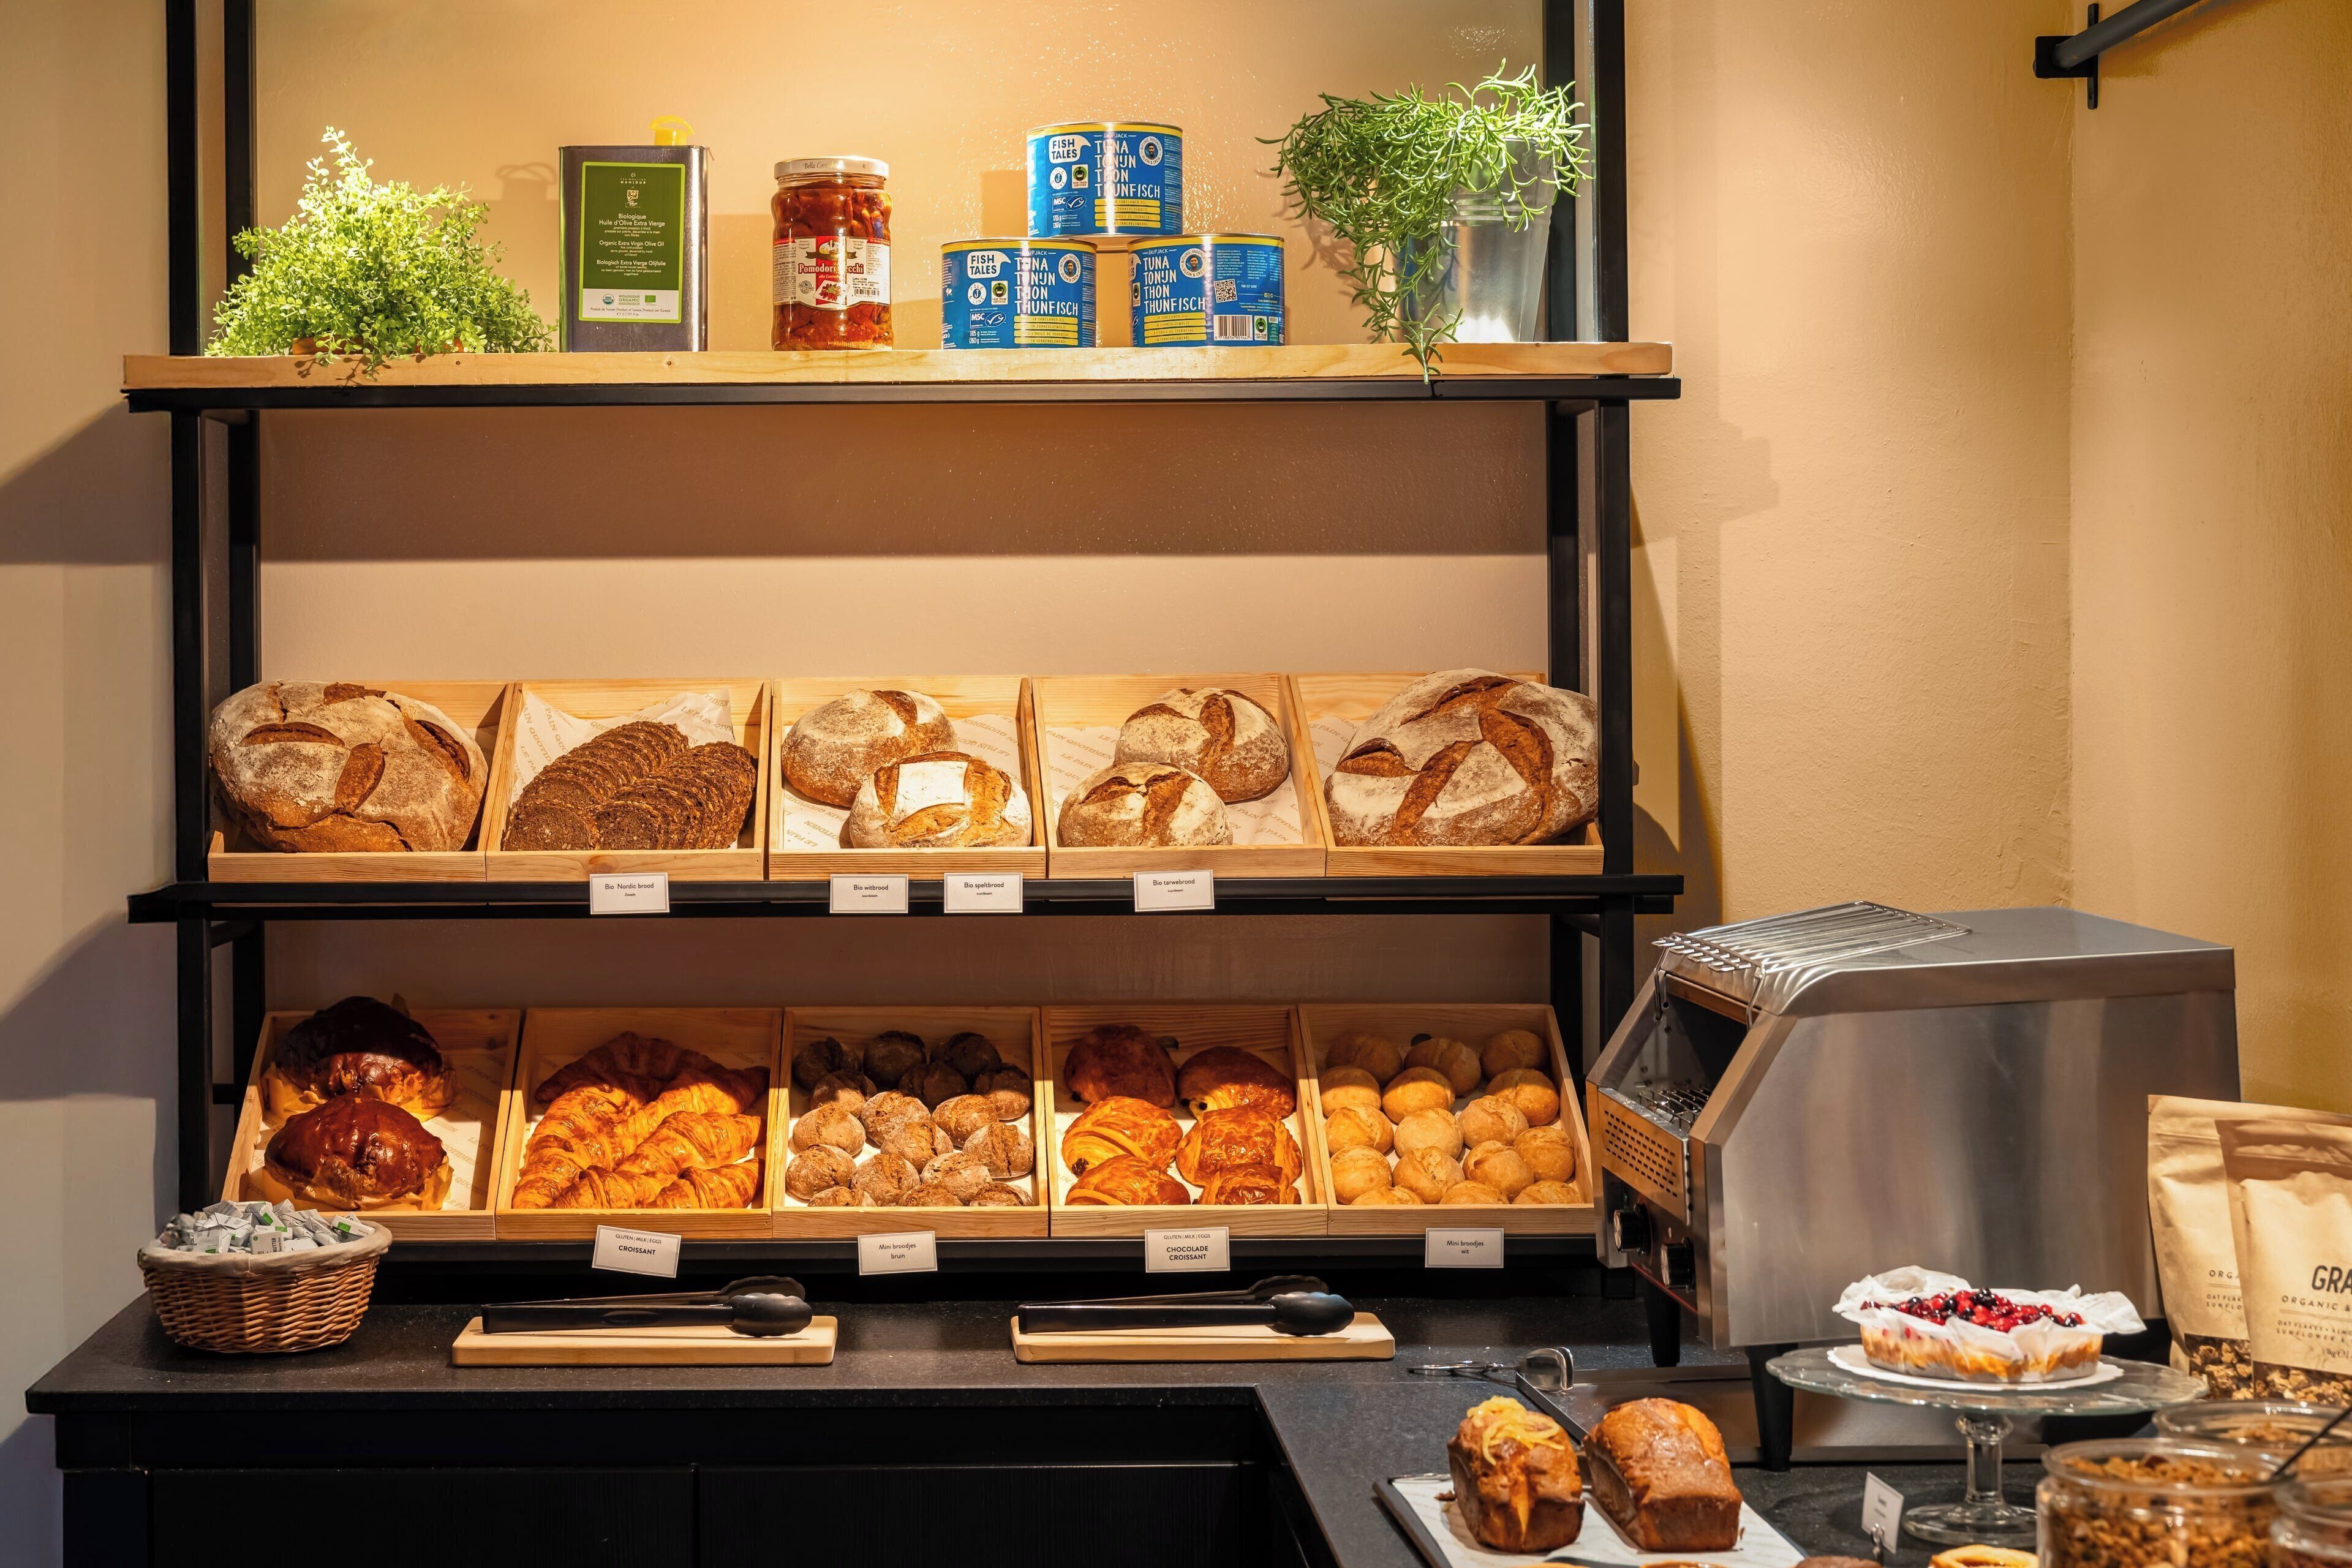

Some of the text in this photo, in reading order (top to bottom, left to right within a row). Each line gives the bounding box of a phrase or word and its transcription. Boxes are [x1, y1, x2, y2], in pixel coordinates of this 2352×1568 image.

[1052, 138, 1075, 149] FISH
[1052, 149, 1077, 160] TALES
[971, 254, 995, 265] FISH
[1143, 255, 1170, 271] TUNA
[798, 263, 837, 274] Pomodori
[970, 265, 997, 275] TALES
[1143, 270, 1177, 285] TONIJN
[1144, 284, 1170, 300] THON
[1014, 300, 1078, 316] THUNFISCH
[1144, 296, 1205, 314] THUNFISCH
[545, 707, 557, 731] PAIN
[681, 706, 693, 714] LE
[692, 711, 711, 725] PAIN
[961, 718, 1007, 736] QUOTIDIEN
[1318, 725, 1341, 736] PAIN
[978, 742, 998, 752] PAIN
[1046, 730, 1114, 760] PAIN QUOTIDIEN
[521, 745, 529, 758] LE
[1073, 759, 1094, 769] PAIN
[1237, 809, 1259, 819] PAIN
[786, 829, 805, 841] PAIN
[1267, 829, 1289, 841] PAIN
[619, 1245, 656, 1255] CROISSANT
[2282, 1295, 2339, 1311] ORGANIC
[2294, 1322, 2323, 1332] FLAKES
[2276, 1328, 2335, 1341] SUNFLOWER
